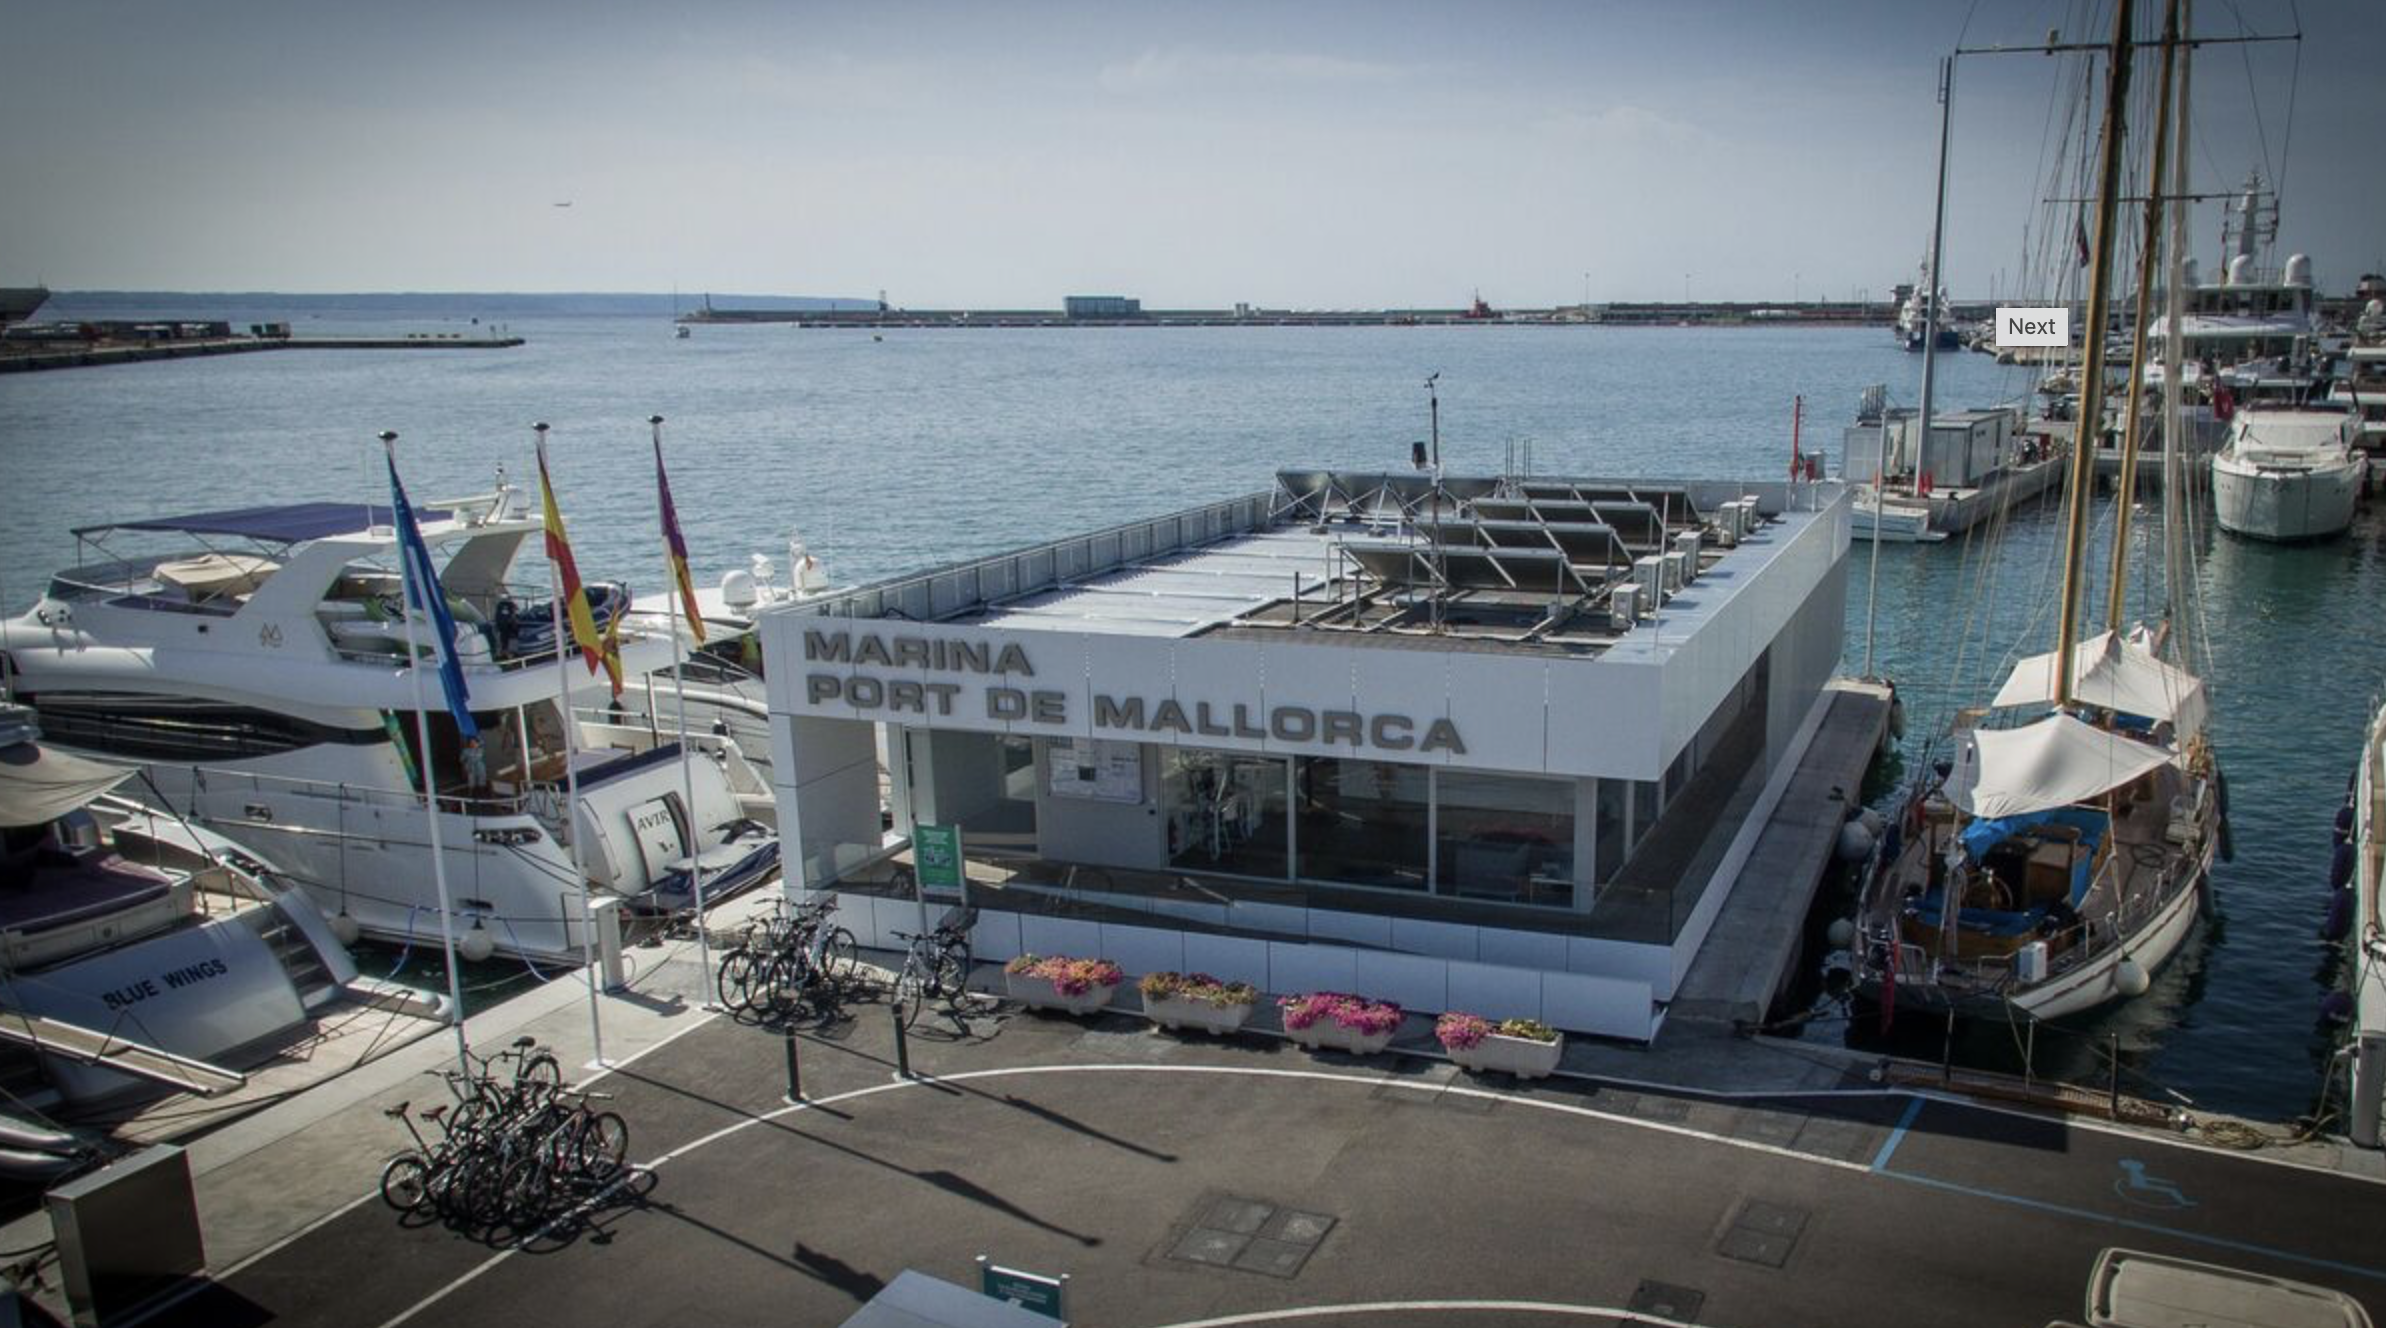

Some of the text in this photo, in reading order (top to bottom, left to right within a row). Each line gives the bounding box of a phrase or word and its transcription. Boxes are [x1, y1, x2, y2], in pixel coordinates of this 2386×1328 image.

[803, 630, 1035, 677] MARINA
[805, 674, 1468, 755] PORT DE MALLORCA
[102, 959, 228, 1011] BLUE WINGS
